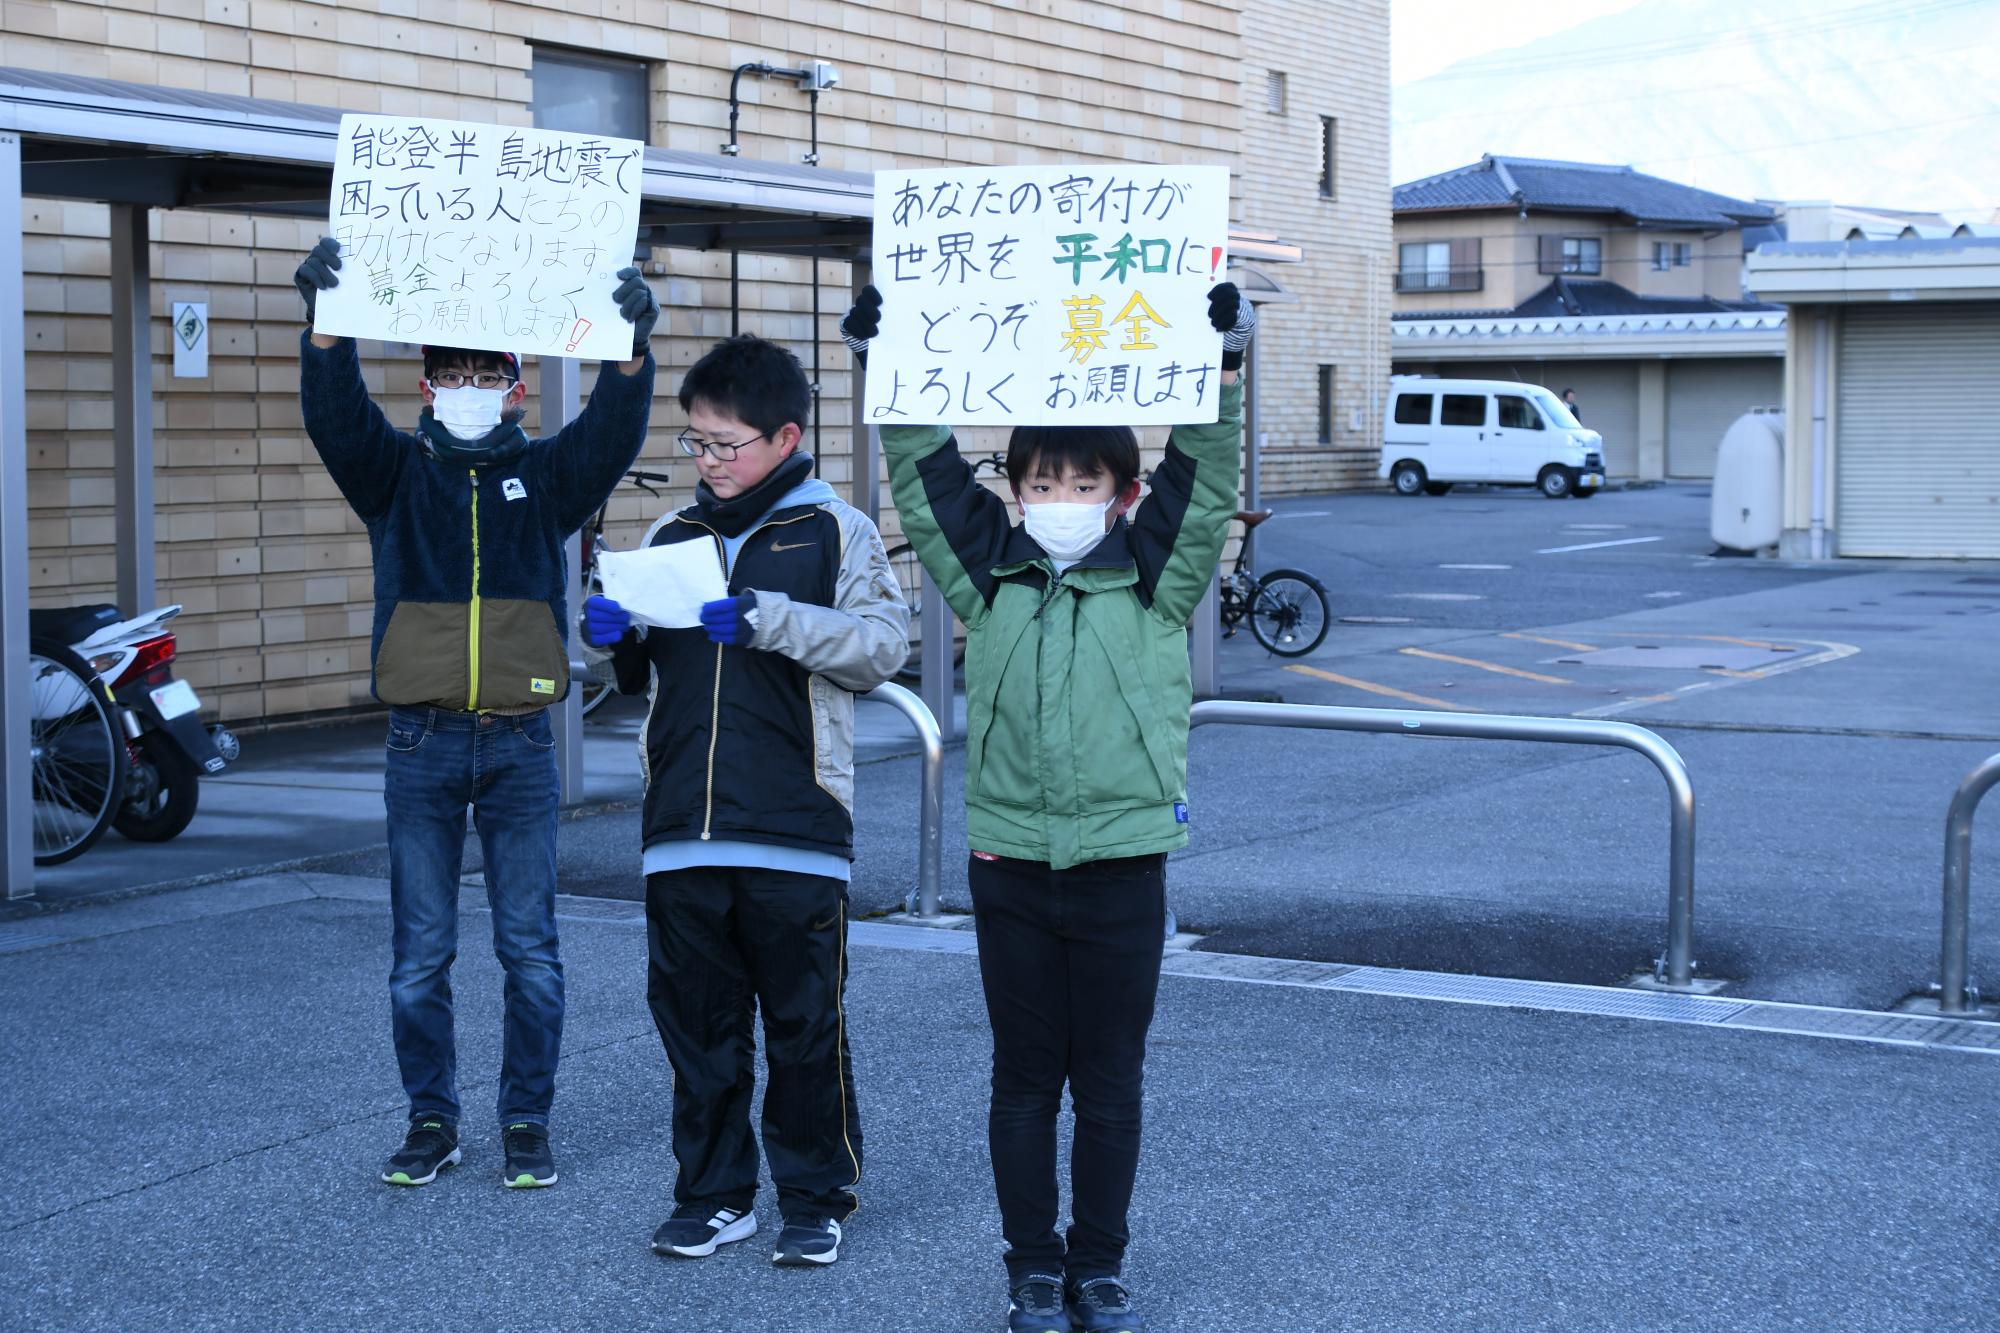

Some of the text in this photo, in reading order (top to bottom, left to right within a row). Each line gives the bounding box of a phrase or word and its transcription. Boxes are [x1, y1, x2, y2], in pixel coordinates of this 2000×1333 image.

[352, 124, 639, 193] 能登半島地震で
[340, 180, 624, 236] 困っている人たちの
[892, 174, 1193, 228] あなたの寄付が
[886, 232, 1021, 286] 世界を
[920, 290, 1174, 365] どうぞ 募金
[873, 367, 1016, 418] よろしく
